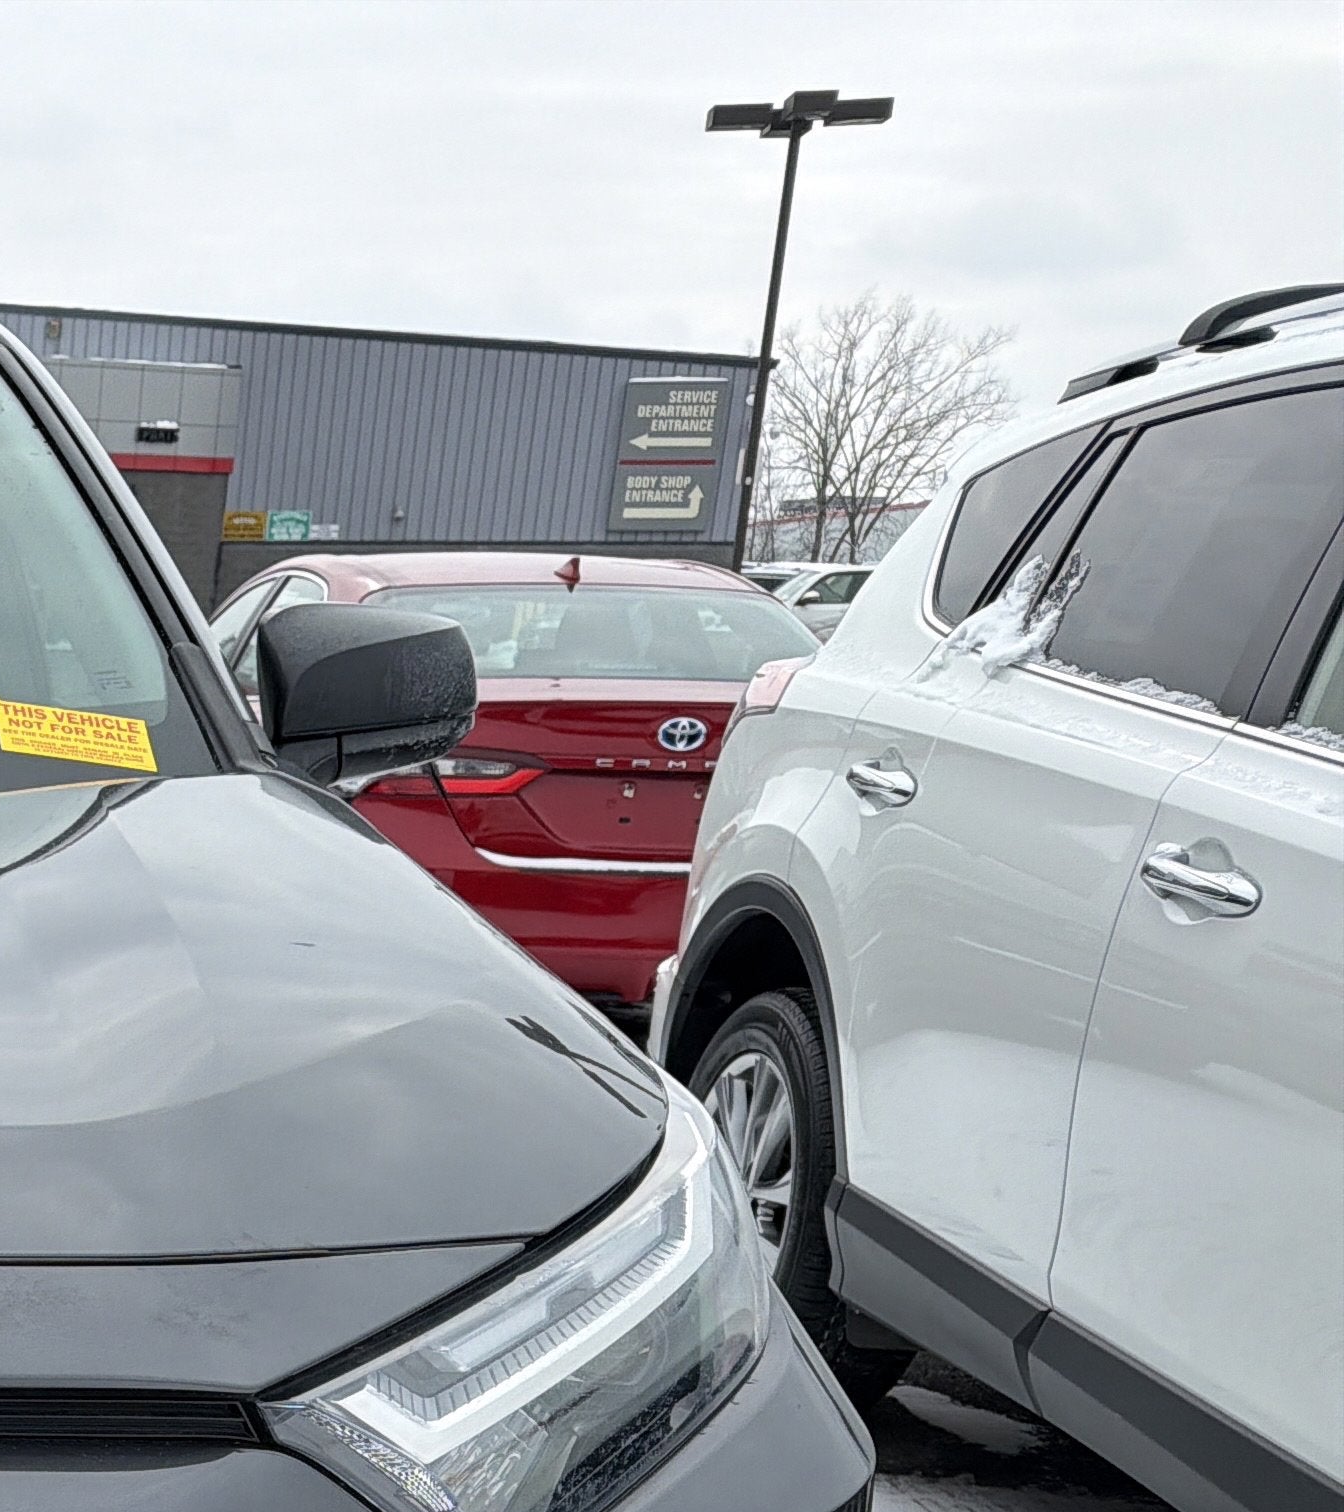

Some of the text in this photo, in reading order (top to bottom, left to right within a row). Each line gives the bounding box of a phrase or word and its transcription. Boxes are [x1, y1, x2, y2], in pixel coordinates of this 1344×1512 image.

[669, 390, 718, 404] SERVICE
[637, 404, 716, 418] DEPARTMENT
[650, 418, 714, 432] ENTRANCE
[626, 475, 691, 490] BODY SHOP
[624, 489, 684, 503] ENTRANCE
[0, 703, 140, 733] THIS VEHICLE
[8, 718, 139, 744] NOT FOR SALE
